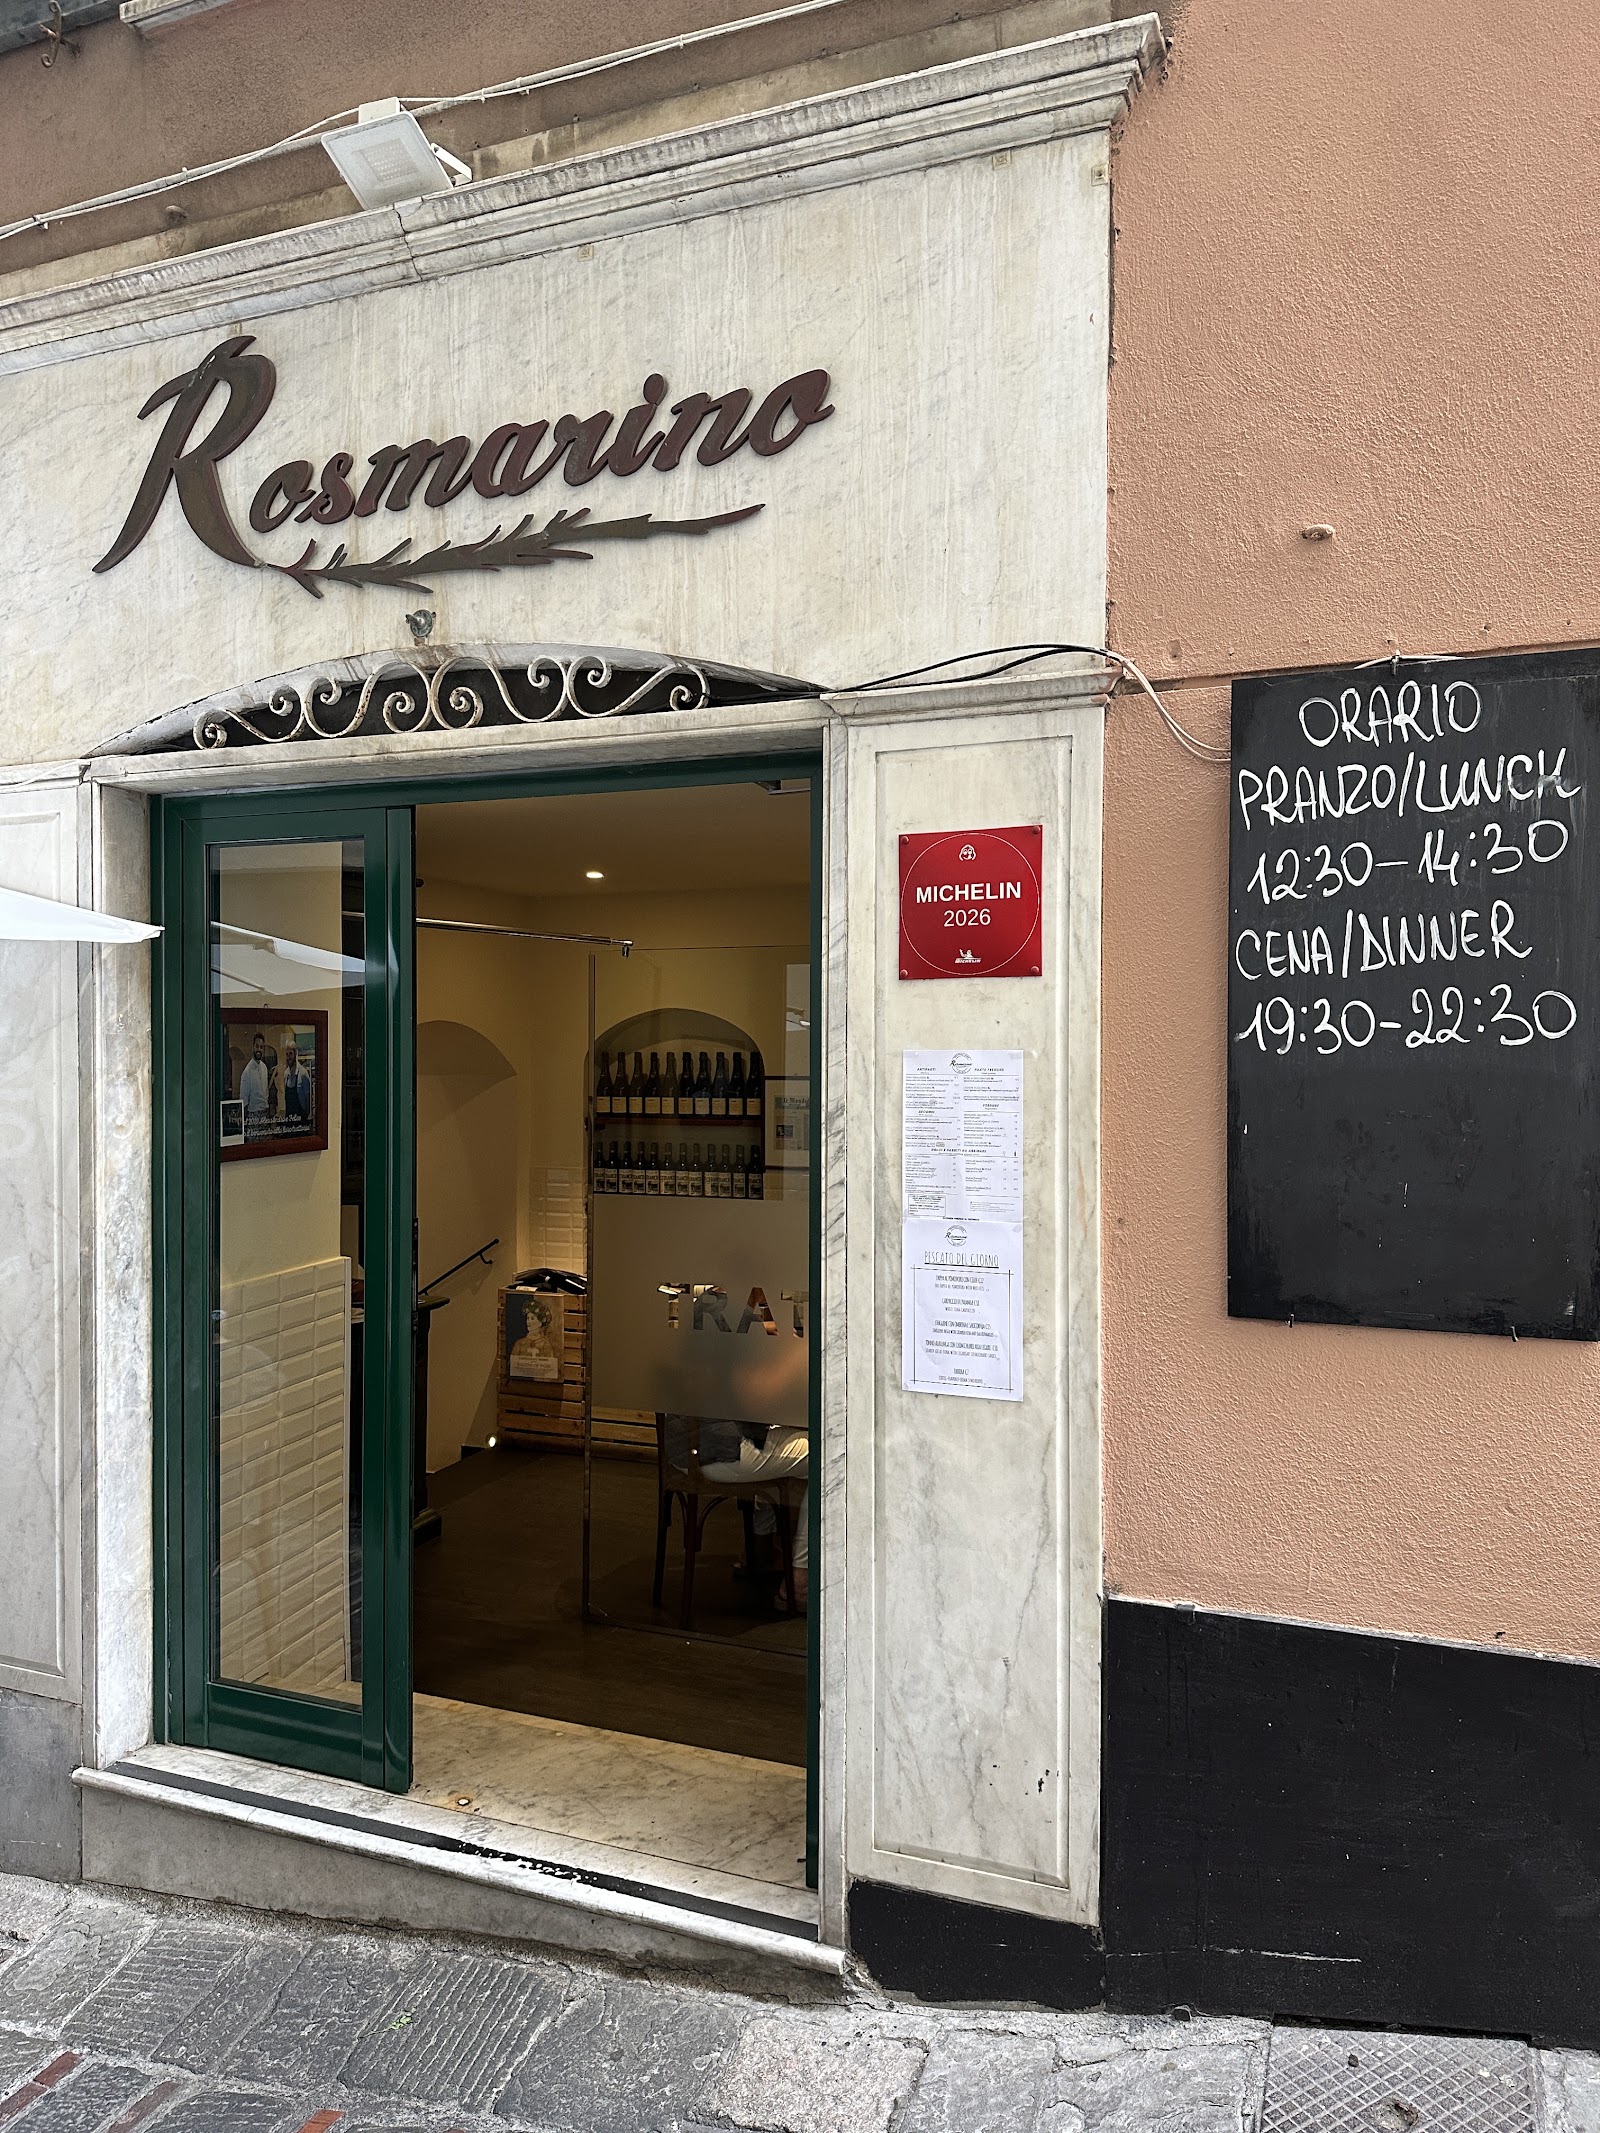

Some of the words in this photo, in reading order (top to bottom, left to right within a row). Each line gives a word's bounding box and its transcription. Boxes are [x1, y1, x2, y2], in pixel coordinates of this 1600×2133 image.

[92, 335, 836, 573] Rosmarino
[1299, 680, 1481, 747] ORARIO
[1238, 748, 1581, 830] PRANZO/LUNCH
[916, 882, 1021, 903] MICHELIN
[943, 908, 991, 927] 2026
[1236, 900, 1532, 980] CENA/DINNER
[924, 1251, 954, 1264] PESCATO
[956, 1253, 968, 1265] DEL
[970, 1254, 999, 1267] GIORNO
